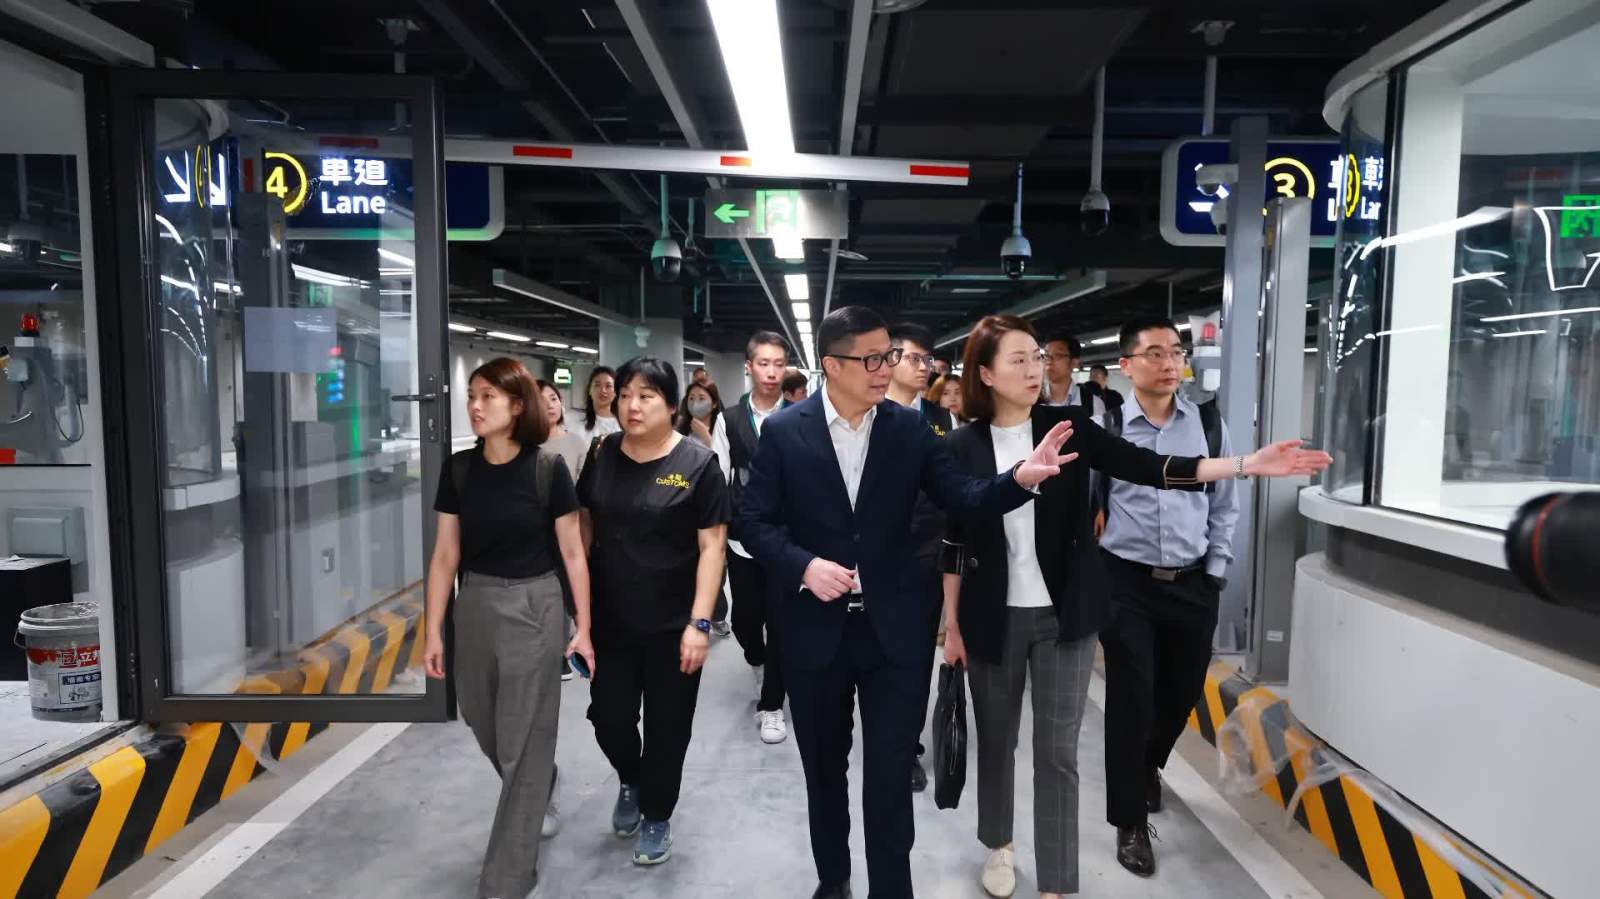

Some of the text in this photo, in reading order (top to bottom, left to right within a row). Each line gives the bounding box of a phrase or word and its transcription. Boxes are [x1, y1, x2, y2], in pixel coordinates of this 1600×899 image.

[266, 166, 288, 198] 4
[319, 158, 389, 186] 車道
[1273, 172, 1296, 199] 3
[321, 191, 386, 214] Lane
[655, 477, 690, 489] CUSTOMS
